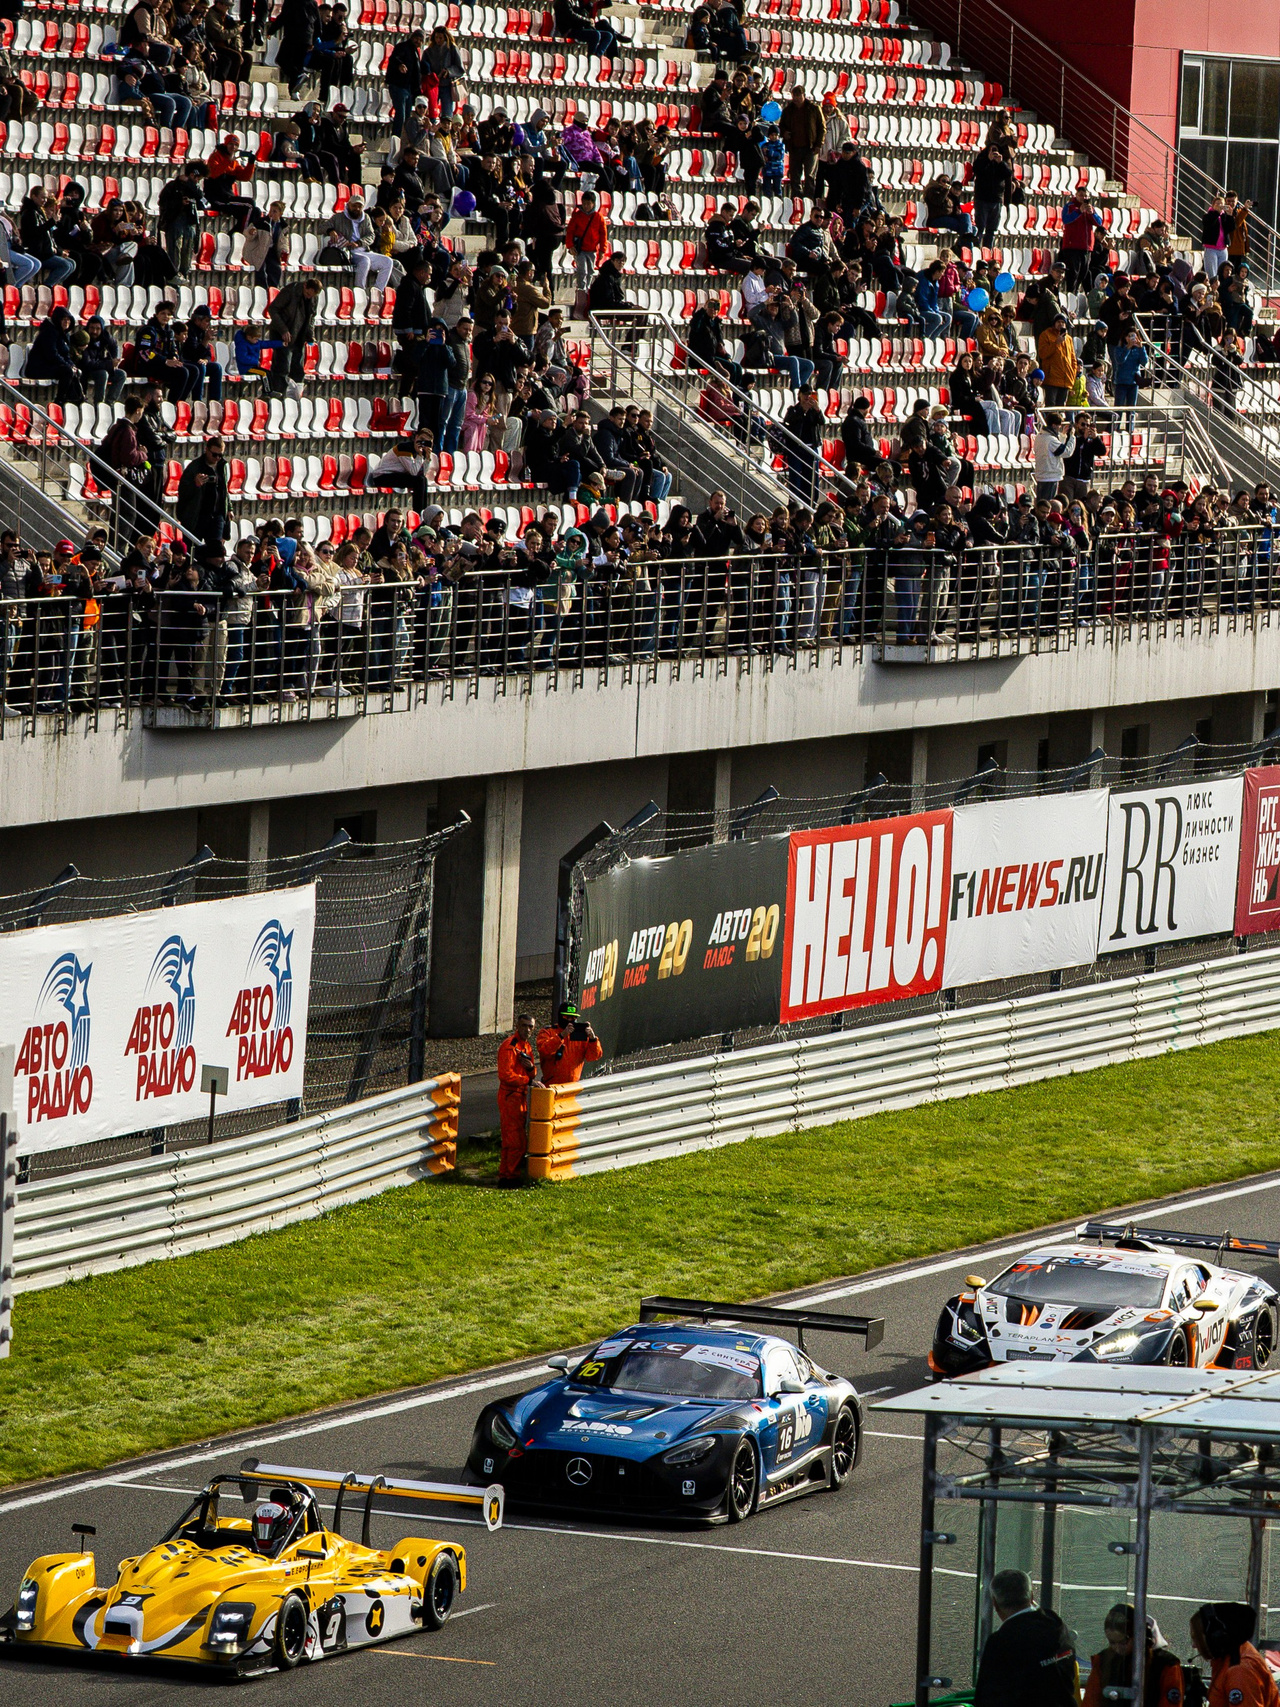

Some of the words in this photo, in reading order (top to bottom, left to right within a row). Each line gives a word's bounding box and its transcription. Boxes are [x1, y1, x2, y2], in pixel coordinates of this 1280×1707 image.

[1259, 796, 1279, 831] РГС
[1109, 796, 1183, 941] RR
[950, 852, 1104, 922] F1NEWS.RU
[1254, 869, 1270, 904] НЬ
[788, 822, 946, 1007] HELLO!
[627, 924, 666, 964] АВТО
[657, 919, 693, 979] 20
[709, 908, 752, 945] АВТО
[745, 903, 779, 962] 20
[703, 945, 735, 969] ПЛЮС
[622, 963, 650, 989] ПЛЮС
[226, 983, 273, 1037] АВТО
[124, 1001, 175, 1056] АВТО
[14, 1020, 69, 1077] АВТО
[237, 1026, 294, 1081] РАДИО
[136, 1045, 196, 1101] РАДИО
[27, 1065, 93, 1124] РАДИО
[1011, 1264, 1043, 1273] 37
[1073, 1252, 1123, 1261] GTS
[1007, 1332, 1055, 1342] TERAPLAN
[577, 1362, 605, 1377] 16
[711, 1351, 751, 1367] СИНТЕРА
[1235, 1356, 1251, 1370] GTS
[559, 1428, 626, 1438] MOTORSPORT
[562, 1420, 633, 1435] YADRO
[780, 1426, 793, 1451] 16
[121, 1596, 142, 1605] 9
[324, 1613, 341, 1647] 9
